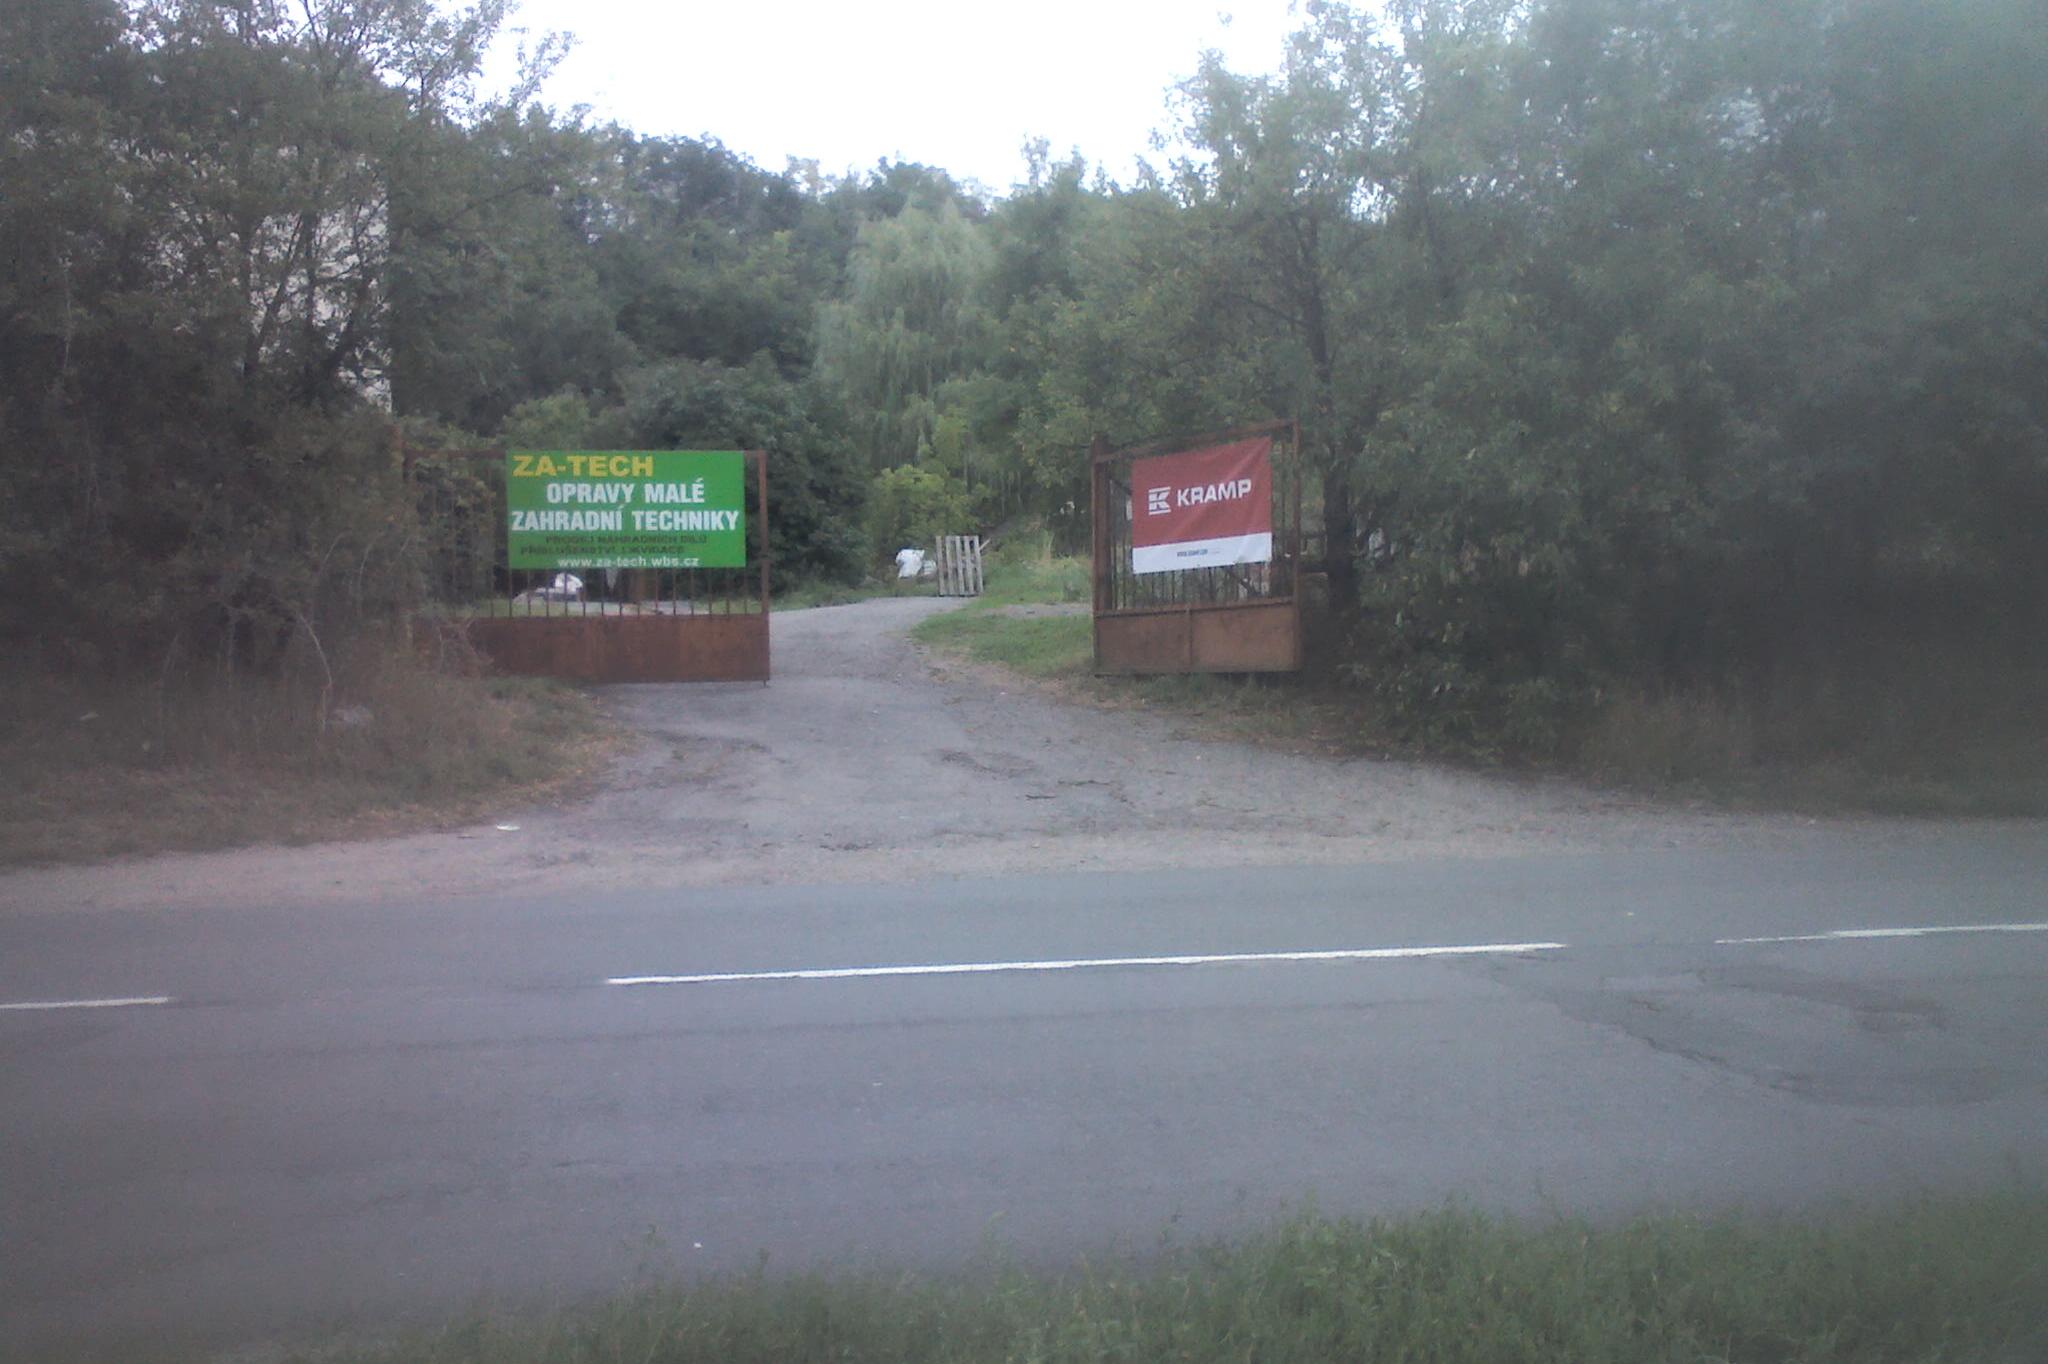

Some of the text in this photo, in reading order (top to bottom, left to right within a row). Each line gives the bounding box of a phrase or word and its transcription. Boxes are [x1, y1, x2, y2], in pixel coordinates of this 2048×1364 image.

[512, 455, 653, 477] ZA-TECH
[547, 478, 704, 503] OPRAVY MALÉ
[1177, 479, 1251, 507] KRAMP
[512, 505, 739, 531] ZAHRADNÍ TECHNIKY
[558, 557, 699, 567] www.za-tech.wbs.cz
